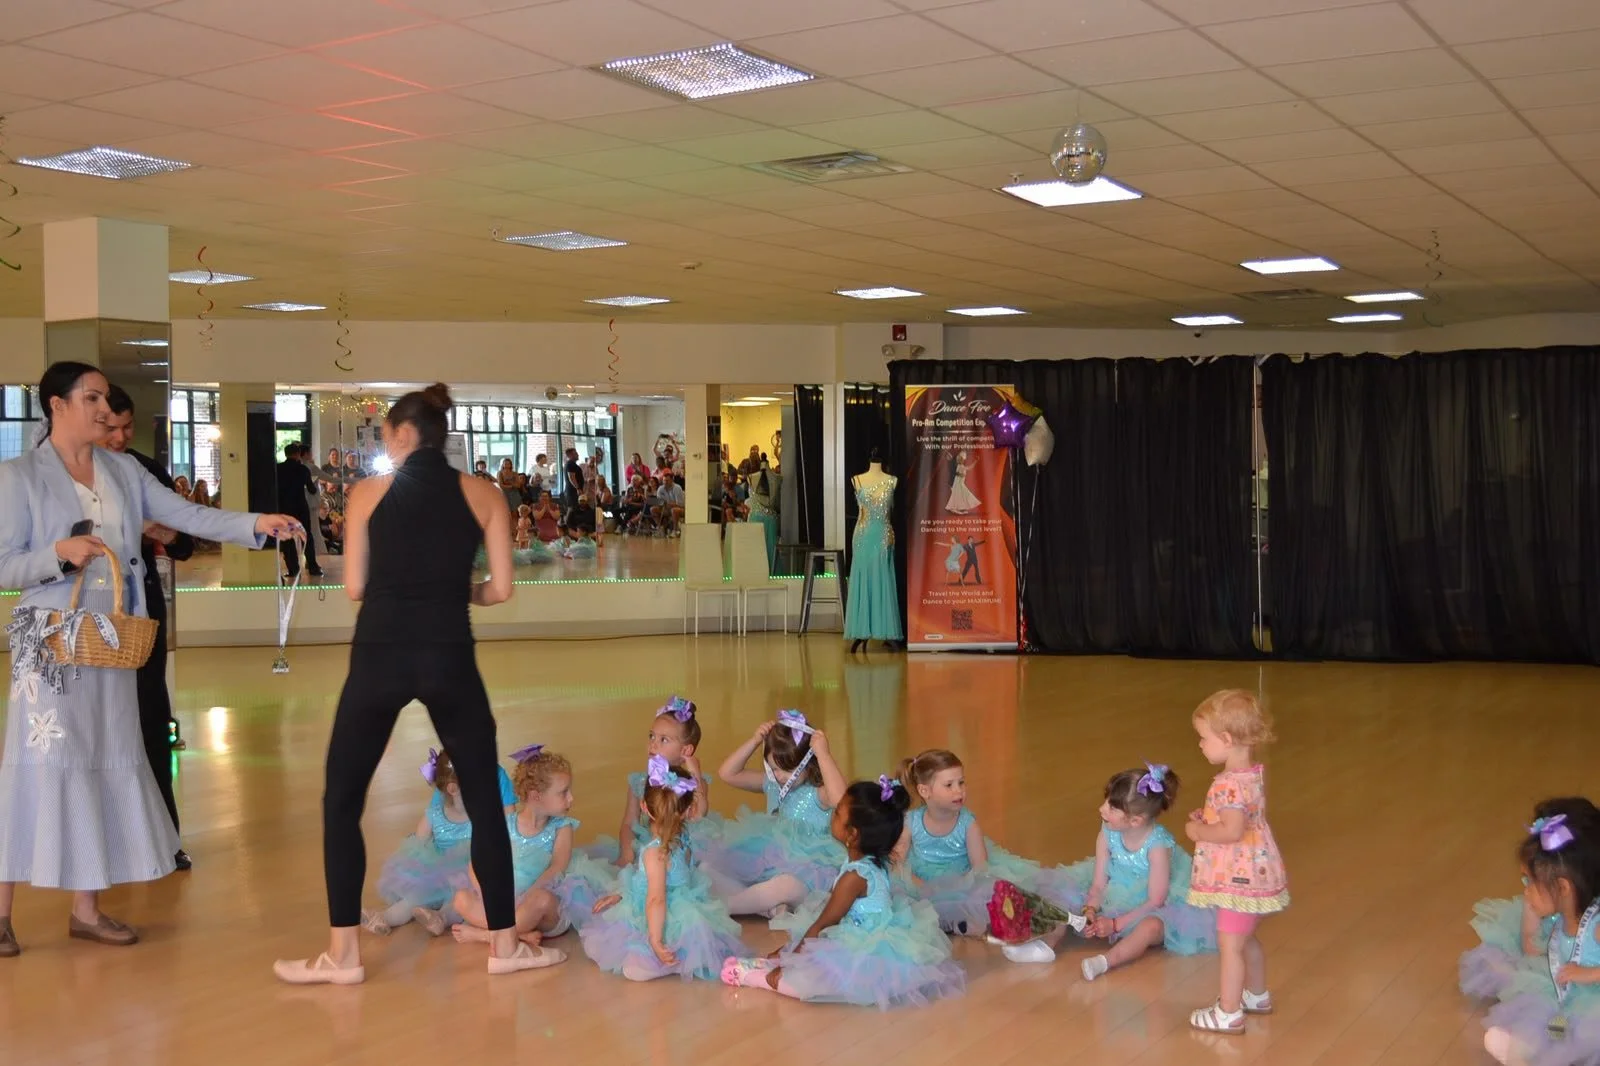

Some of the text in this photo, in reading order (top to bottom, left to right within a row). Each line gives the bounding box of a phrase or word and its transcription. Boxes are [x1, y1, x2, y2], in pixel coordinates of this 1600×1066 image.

[929, 400, 991, 415] Dance Fire
[912, 419, 934, 427] Pro-Am
[936, 418, 973, 428] Competition
